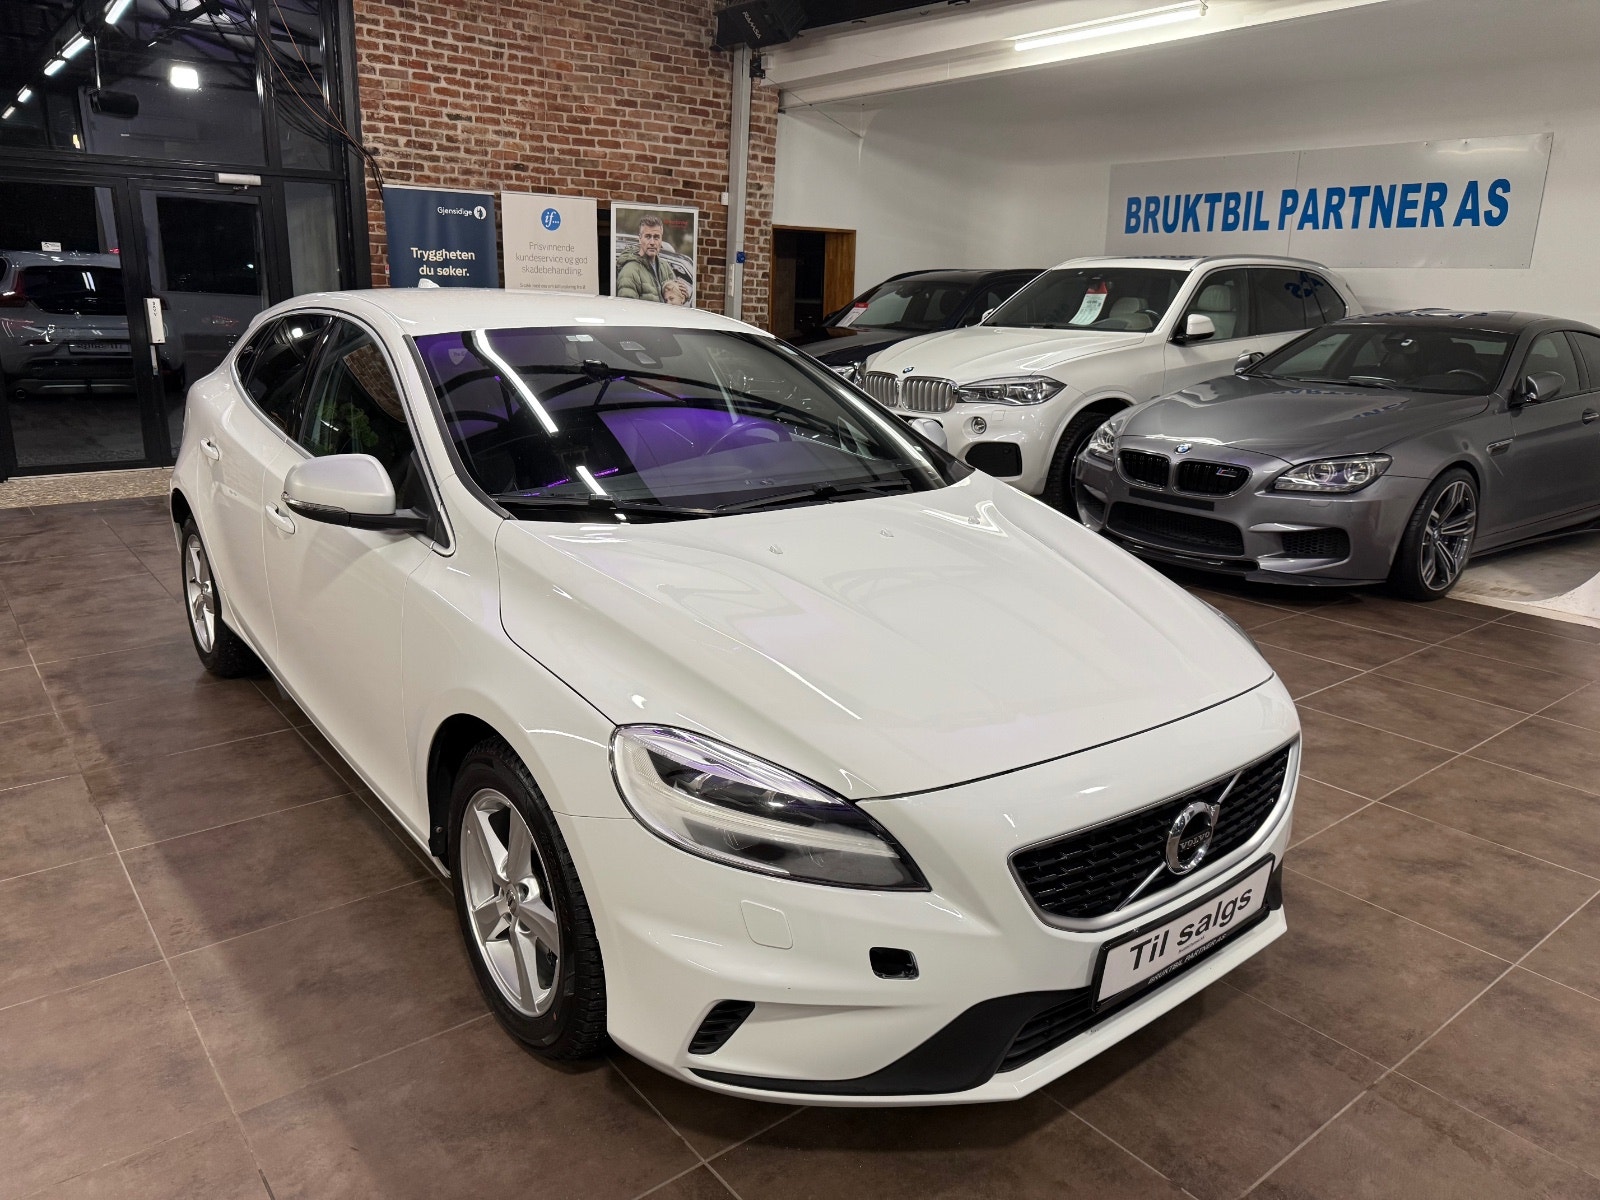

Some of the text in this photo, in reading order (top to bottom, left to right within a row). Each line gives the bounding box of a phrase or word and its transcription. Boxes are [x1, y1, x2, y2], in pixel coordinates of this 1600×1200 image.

[437, 206, 473, 217] Gjensidige
[1124, 178, 1511, 235] BRUKTBIL PARTNER AS
[410, 247, 476, 262] Tryggheten
[515, 252, 588, 266] kundeservice og god
[418, 264, 470, 277] du søker.
[1180, 831, 1211, 850] VOLVO
[1129, 888, 1253, 971] Til salgs
